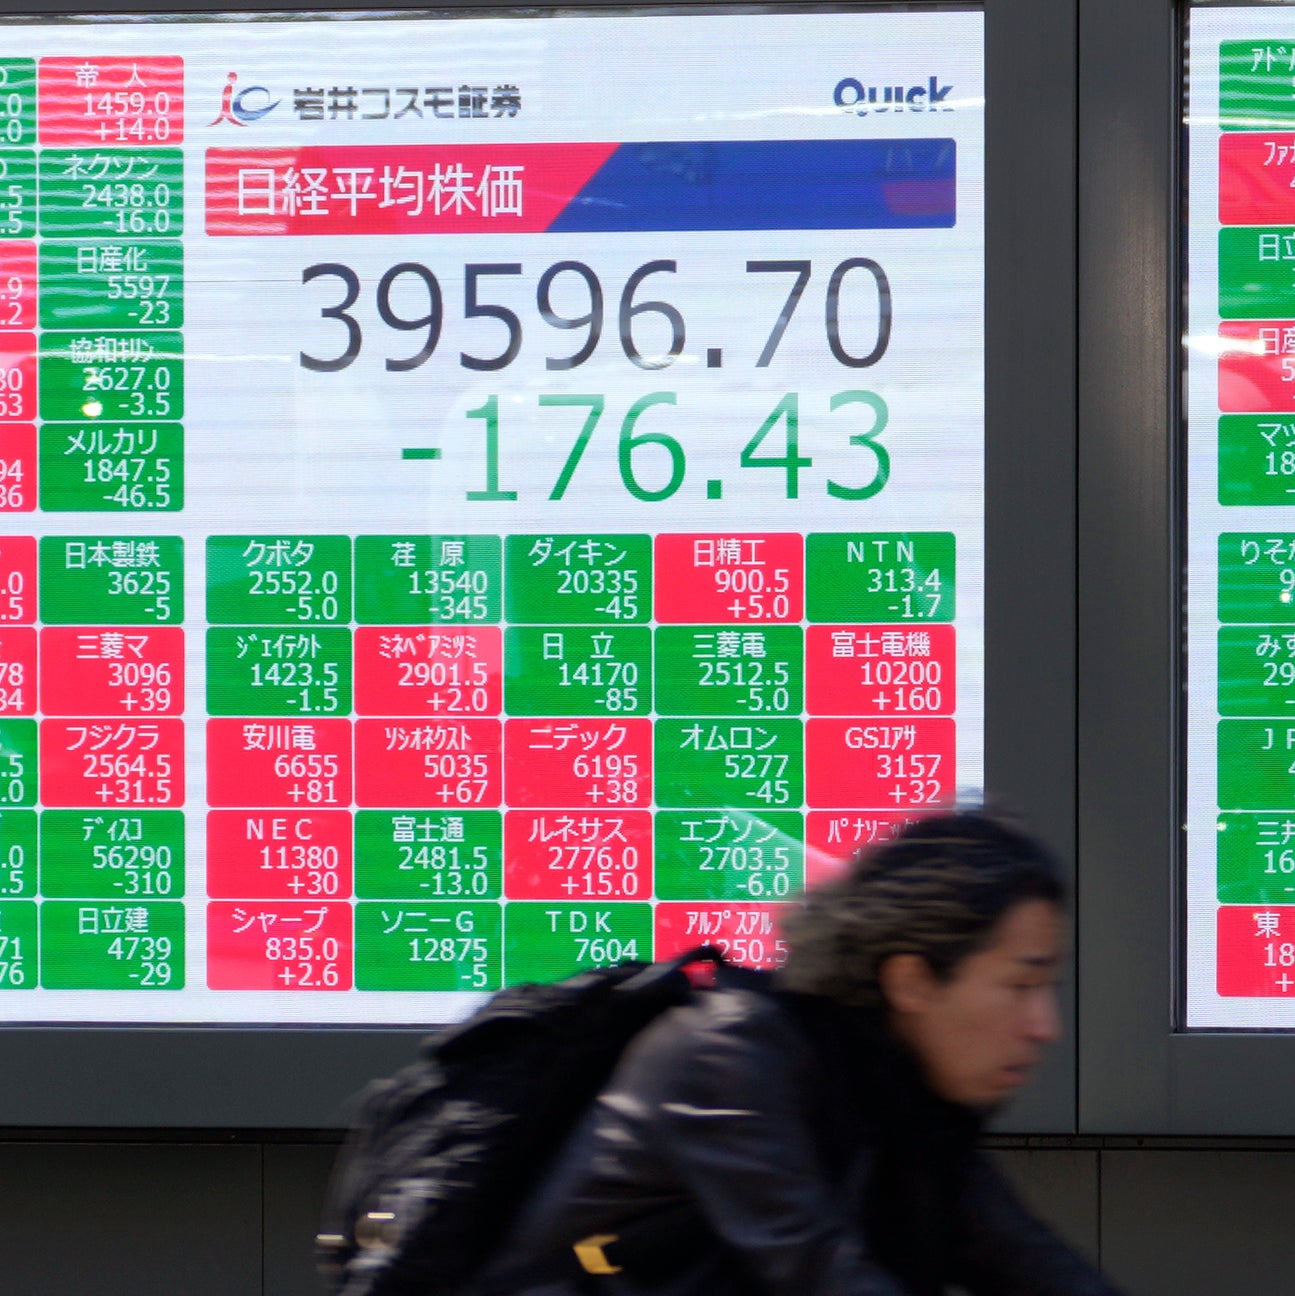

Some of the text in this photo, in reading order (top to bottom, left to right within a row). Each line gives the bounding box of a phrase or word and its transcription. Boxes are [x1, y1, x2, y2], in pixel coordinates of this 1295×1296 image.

[292, 84, 522, 120] 岩井コスモ証券
[833, 75, 955, 117] Quick
[236, 163, 525, 218] 日経平均株価
[300, 257, 893, 373] 39596.70
[63, 427, 158, 456] メルカリ
[400, 390, 891, 503] -176.43
[83, 457, 171, 484] 1847.5
[102, 482, 171, 508] -46.5
[65, 539, 161, 570] 日本製鉄
[241, 539, 315, 568] クボタ
[527, 537, 627, 567] ダイキン
[107, 570, 171, 597] 3625
[248, 569, 339, 596] 2552.0
[556, 569, 638, 596] 20335
[144, 595, 171, 622] -5
[285, 594, 339, 621] -5.0
[594, 594, 639, 621] -45
[830, 629, 930, 658] 富士電機
[860, 660, 942, 686] 10200
[871, 686, 942, 712] +160
[66, 723, 160, 751] フジクラ
[242, 722, 317, 751] 安川電
[82, 753, 172, 779] 2564.5
[273, 753, 339, 779] 6655
[95, 778, 172, 804] +31.5
[286, 778, 338, 804] +81
[527, 814, 628, 843] ルネサス
[548, 845, 639, 871] 2776.0
[560, 871, 639, 896] +15.0
[78, 905, 149, 935] 日立建
[231, 905, 329, 935] シャープ
[106, 936, 172, 962] 4739
[265, 936, 340, 962] 835.0
[128, 961, 172, 985] -29
[277, 961, 339, 987] +2.6
